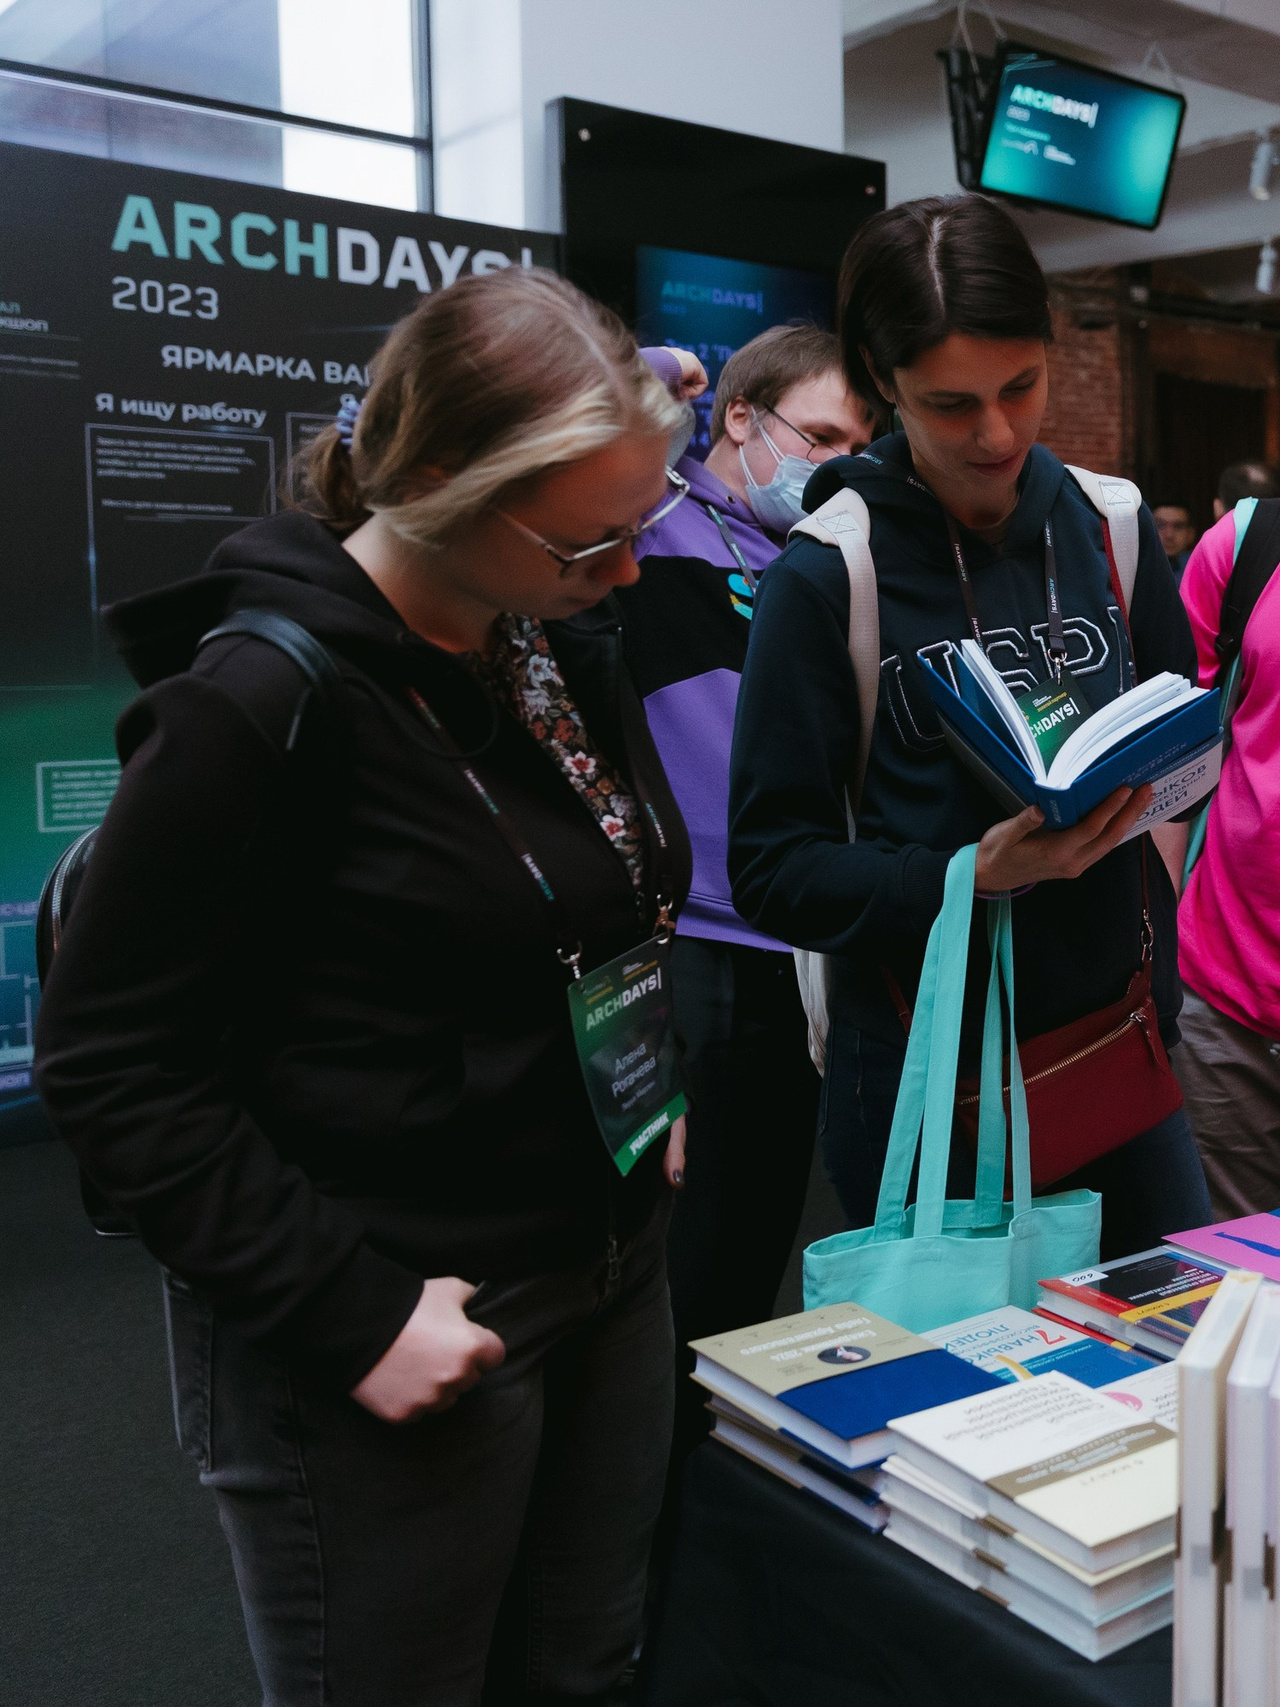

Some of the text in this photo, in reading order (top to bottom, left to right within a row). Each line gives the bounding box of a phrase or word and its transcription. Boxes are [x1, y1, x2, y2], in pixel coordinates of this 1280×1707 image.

[112, 276, 219, 320] 2023
[161, 345, 316, 381] ЯРМАРКА
[95, 392, 267, 428] Я ищу работу
[629, 1111, 669, 1156] УЧАСТНИК
[1034, 1330, 1067, 1346] 7
